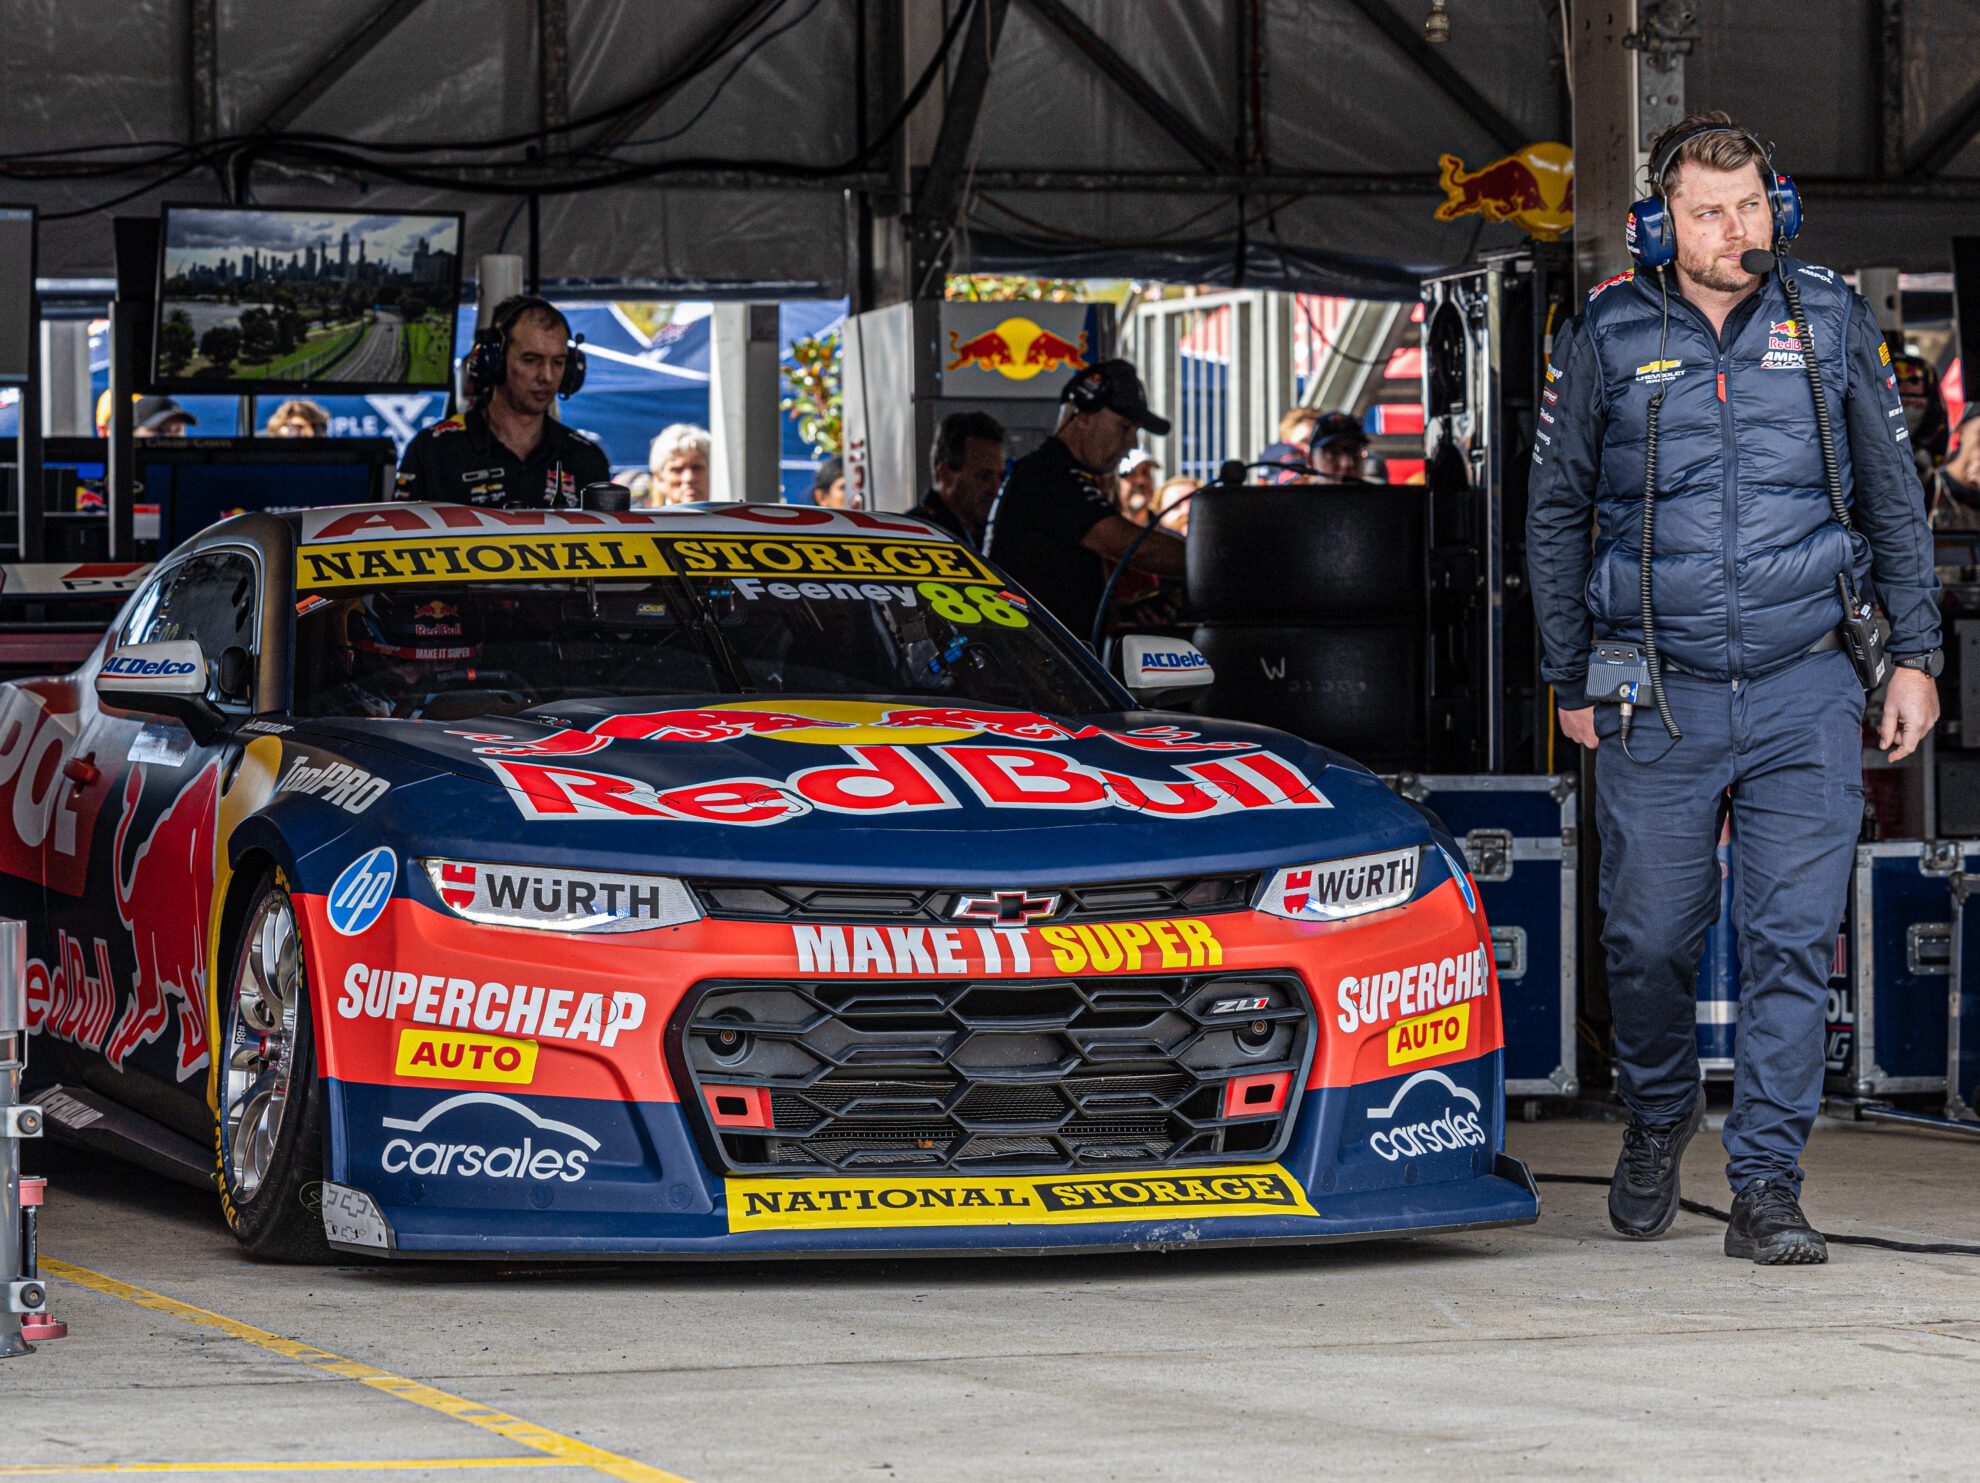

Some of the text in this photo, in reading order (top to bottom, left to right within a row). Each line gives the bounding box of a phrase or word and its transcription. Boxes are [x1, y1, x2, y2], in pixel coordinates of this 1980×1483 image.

[1761, 351, 1804, 363] AMP
[1768, 337, 1792, 350] Red
[303, 541, 971, 582] NATIONAL STORAGE
[730, 578, 1029, 628] Feeney 88
[101, 656, 196, 675] ACDelco
[416, 646, 470, 659] MAKE IT SUPER
[280, 755, 391, 814] ToolPRO
[479, 745, 1335, 827] Red Bull
[335, 850, 388, 935] hp
[486, 873, 660, 919] WÜRTH
[1318, 856, 1414, 903] WÜRTH
[791, 919, 1224, 974] MAKE IT SUPER
[26, 928, 69, 1038] ed
[337, 962, 647, 1048] SUPERCHEAP
[1212, 997, 1270, 1014] ZL1
[410, 1041, 522, 1073] AUTO
[1395, 1016, 1460, 1054] AUTO
[1369, 1107, 1486, 1162] carsales
[381, 1137, 590, 1183] carsales
[743, 1176, 1284, 1217] NATIONAL STORAGE
